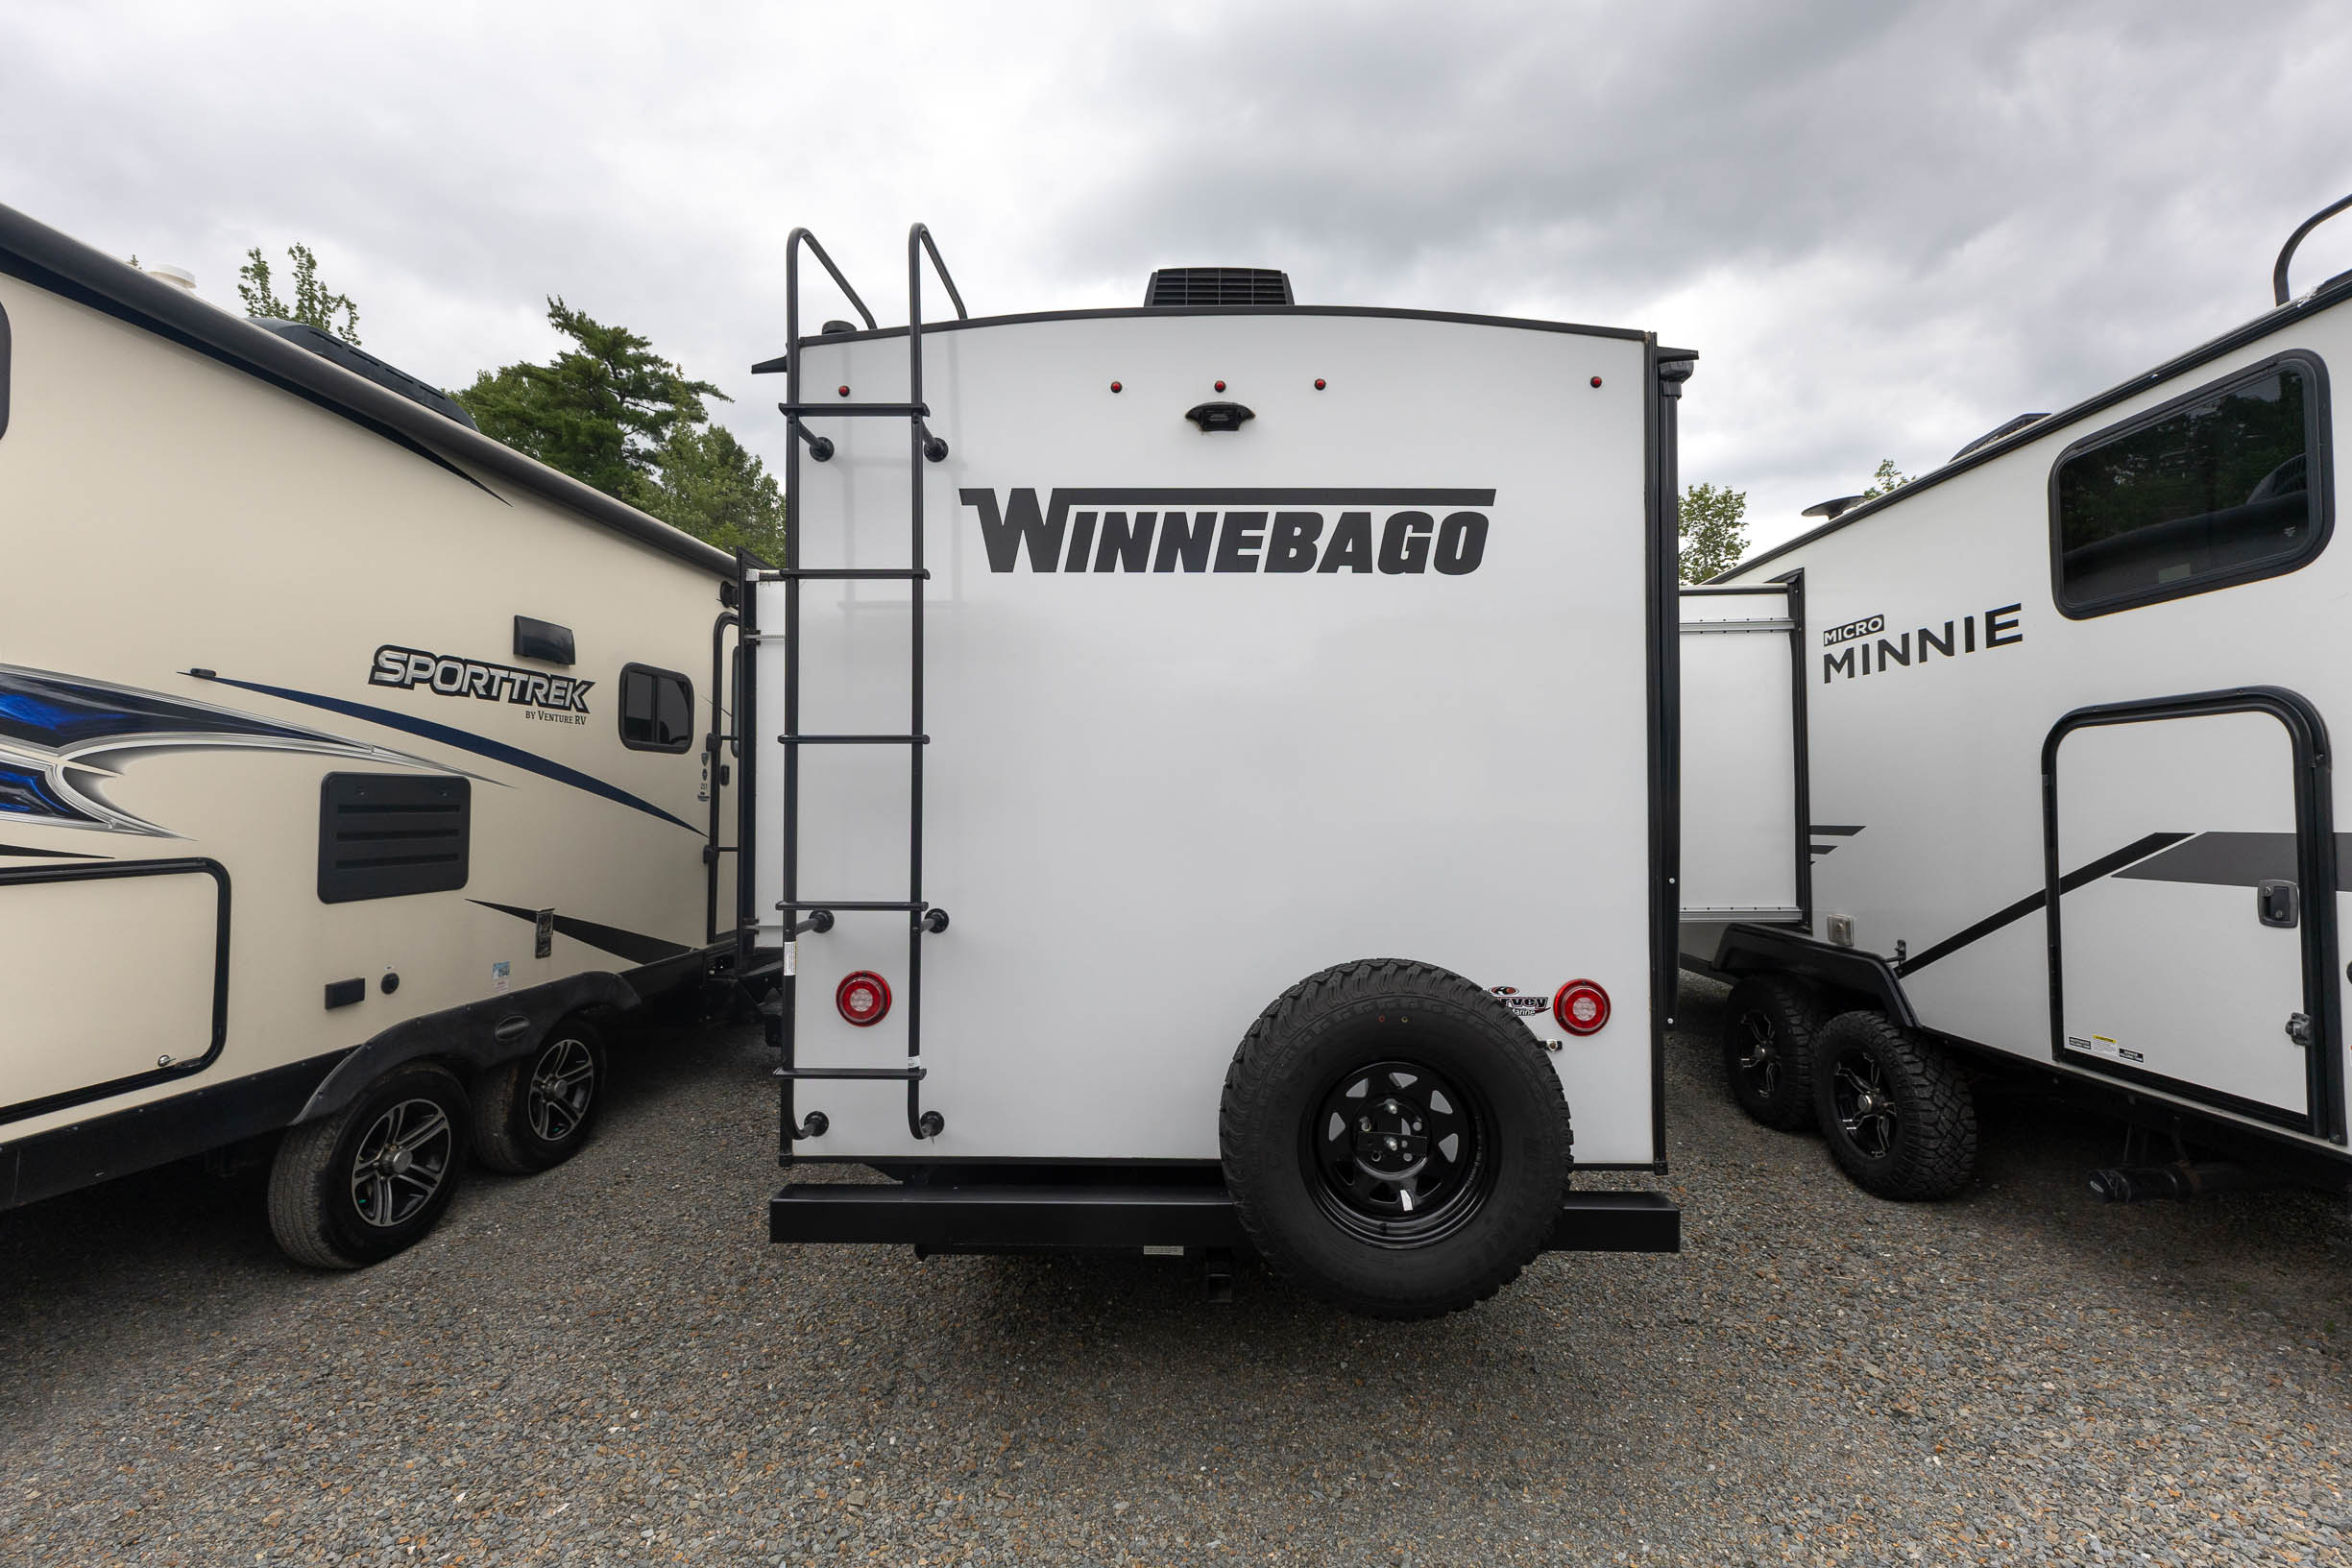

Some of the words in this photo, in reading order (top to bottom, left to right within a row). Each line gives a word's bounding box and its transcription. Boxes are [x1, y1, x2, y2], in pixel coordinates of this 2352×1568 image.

[958, 488, 1496, 575] WINNEBAGO
[1824, 615, 1883, 645] MICRO
[1824, 602, 2023, 684] MINNIE
[371, 647, 594, 712] SPORTTREK
[525, 711, 536, 720] BY
[574, 714, 587, 726] RV
[1512, 1007, 1536, 1016] arine
